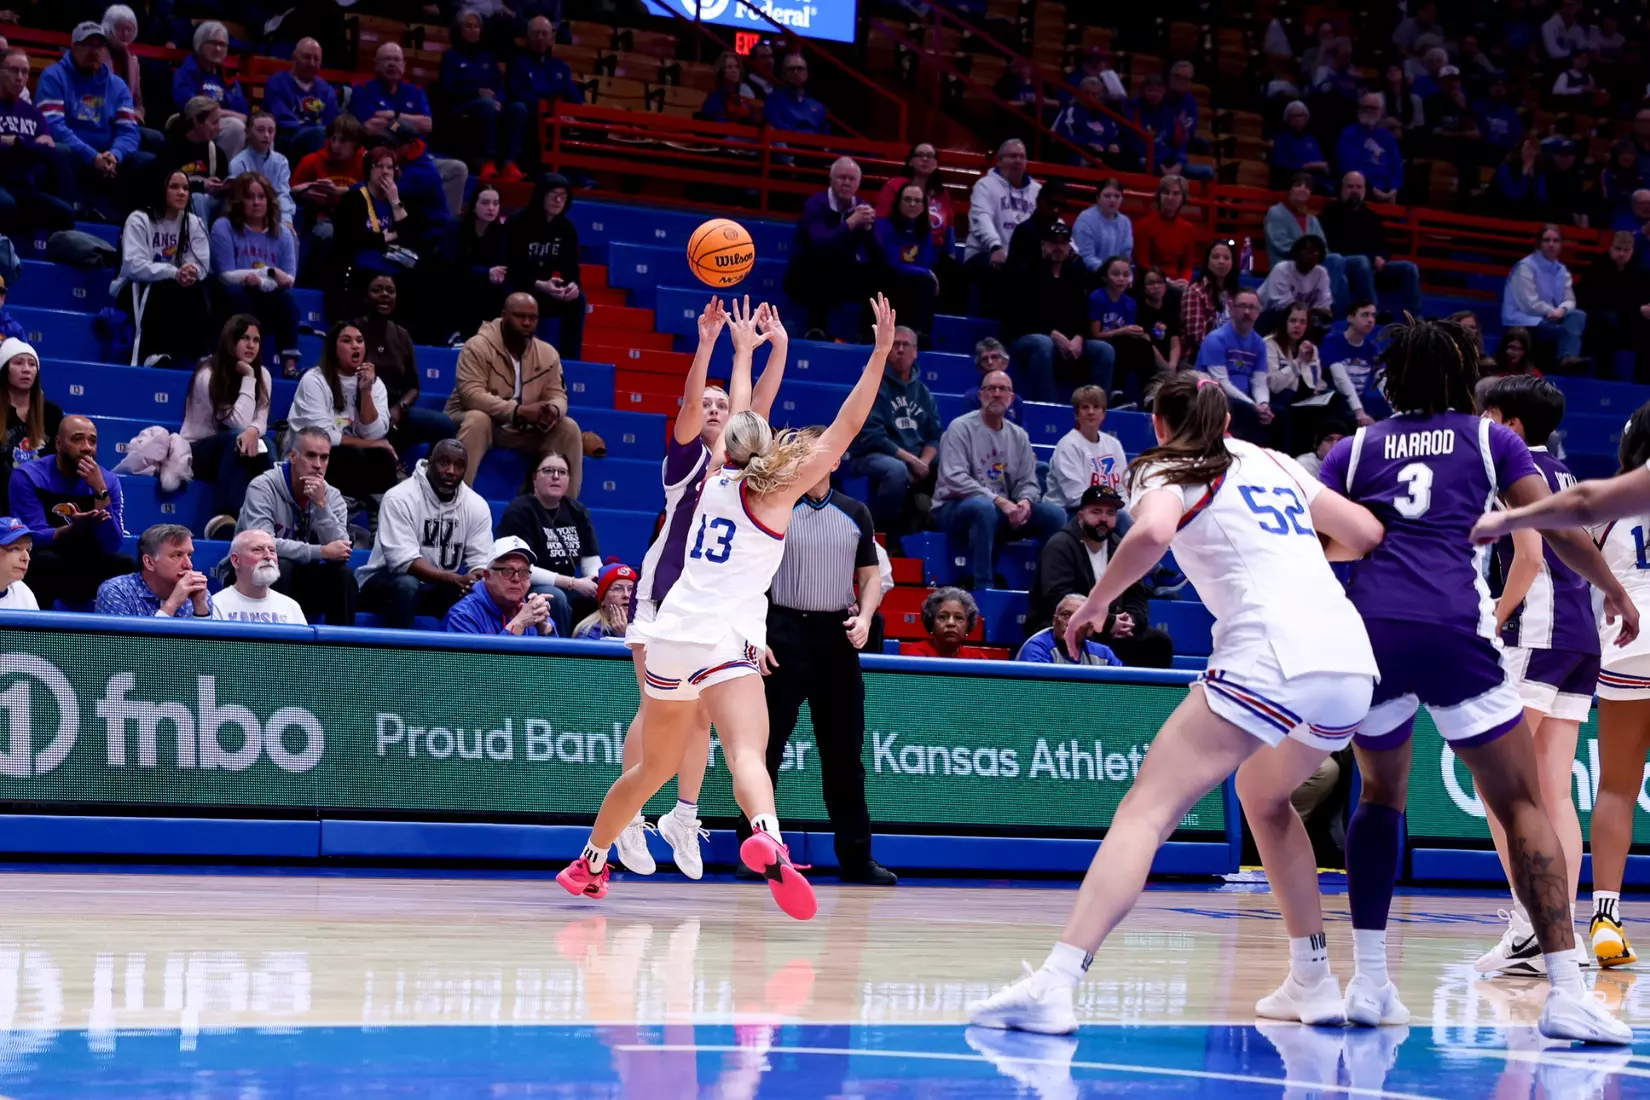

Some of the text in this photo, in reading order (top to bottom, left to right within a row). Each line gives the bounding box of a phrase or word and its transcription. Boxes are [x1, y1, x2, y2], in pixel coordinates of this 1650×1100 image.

[735, 0, 810, 28] Federal
[736, 32, 760, 55] EXIT
[715, 252, 753, 267] Wilson
[73, 386, 81, 395] 13
[1384, 429, 1456, 459] HARROD
[1392, 462, 1434, 520] 3
[1237, 485, 1316, 537] 52
[690, 514, 736, 563] 13
[228, 612, 288, 623] KANSAS
[97, 672, 324, 772] fnbo
[376, 713, 513, 760] Proud
[874, 732, 1018, 777] Kansas
[1029, 738, 1150, 781] Athleti
